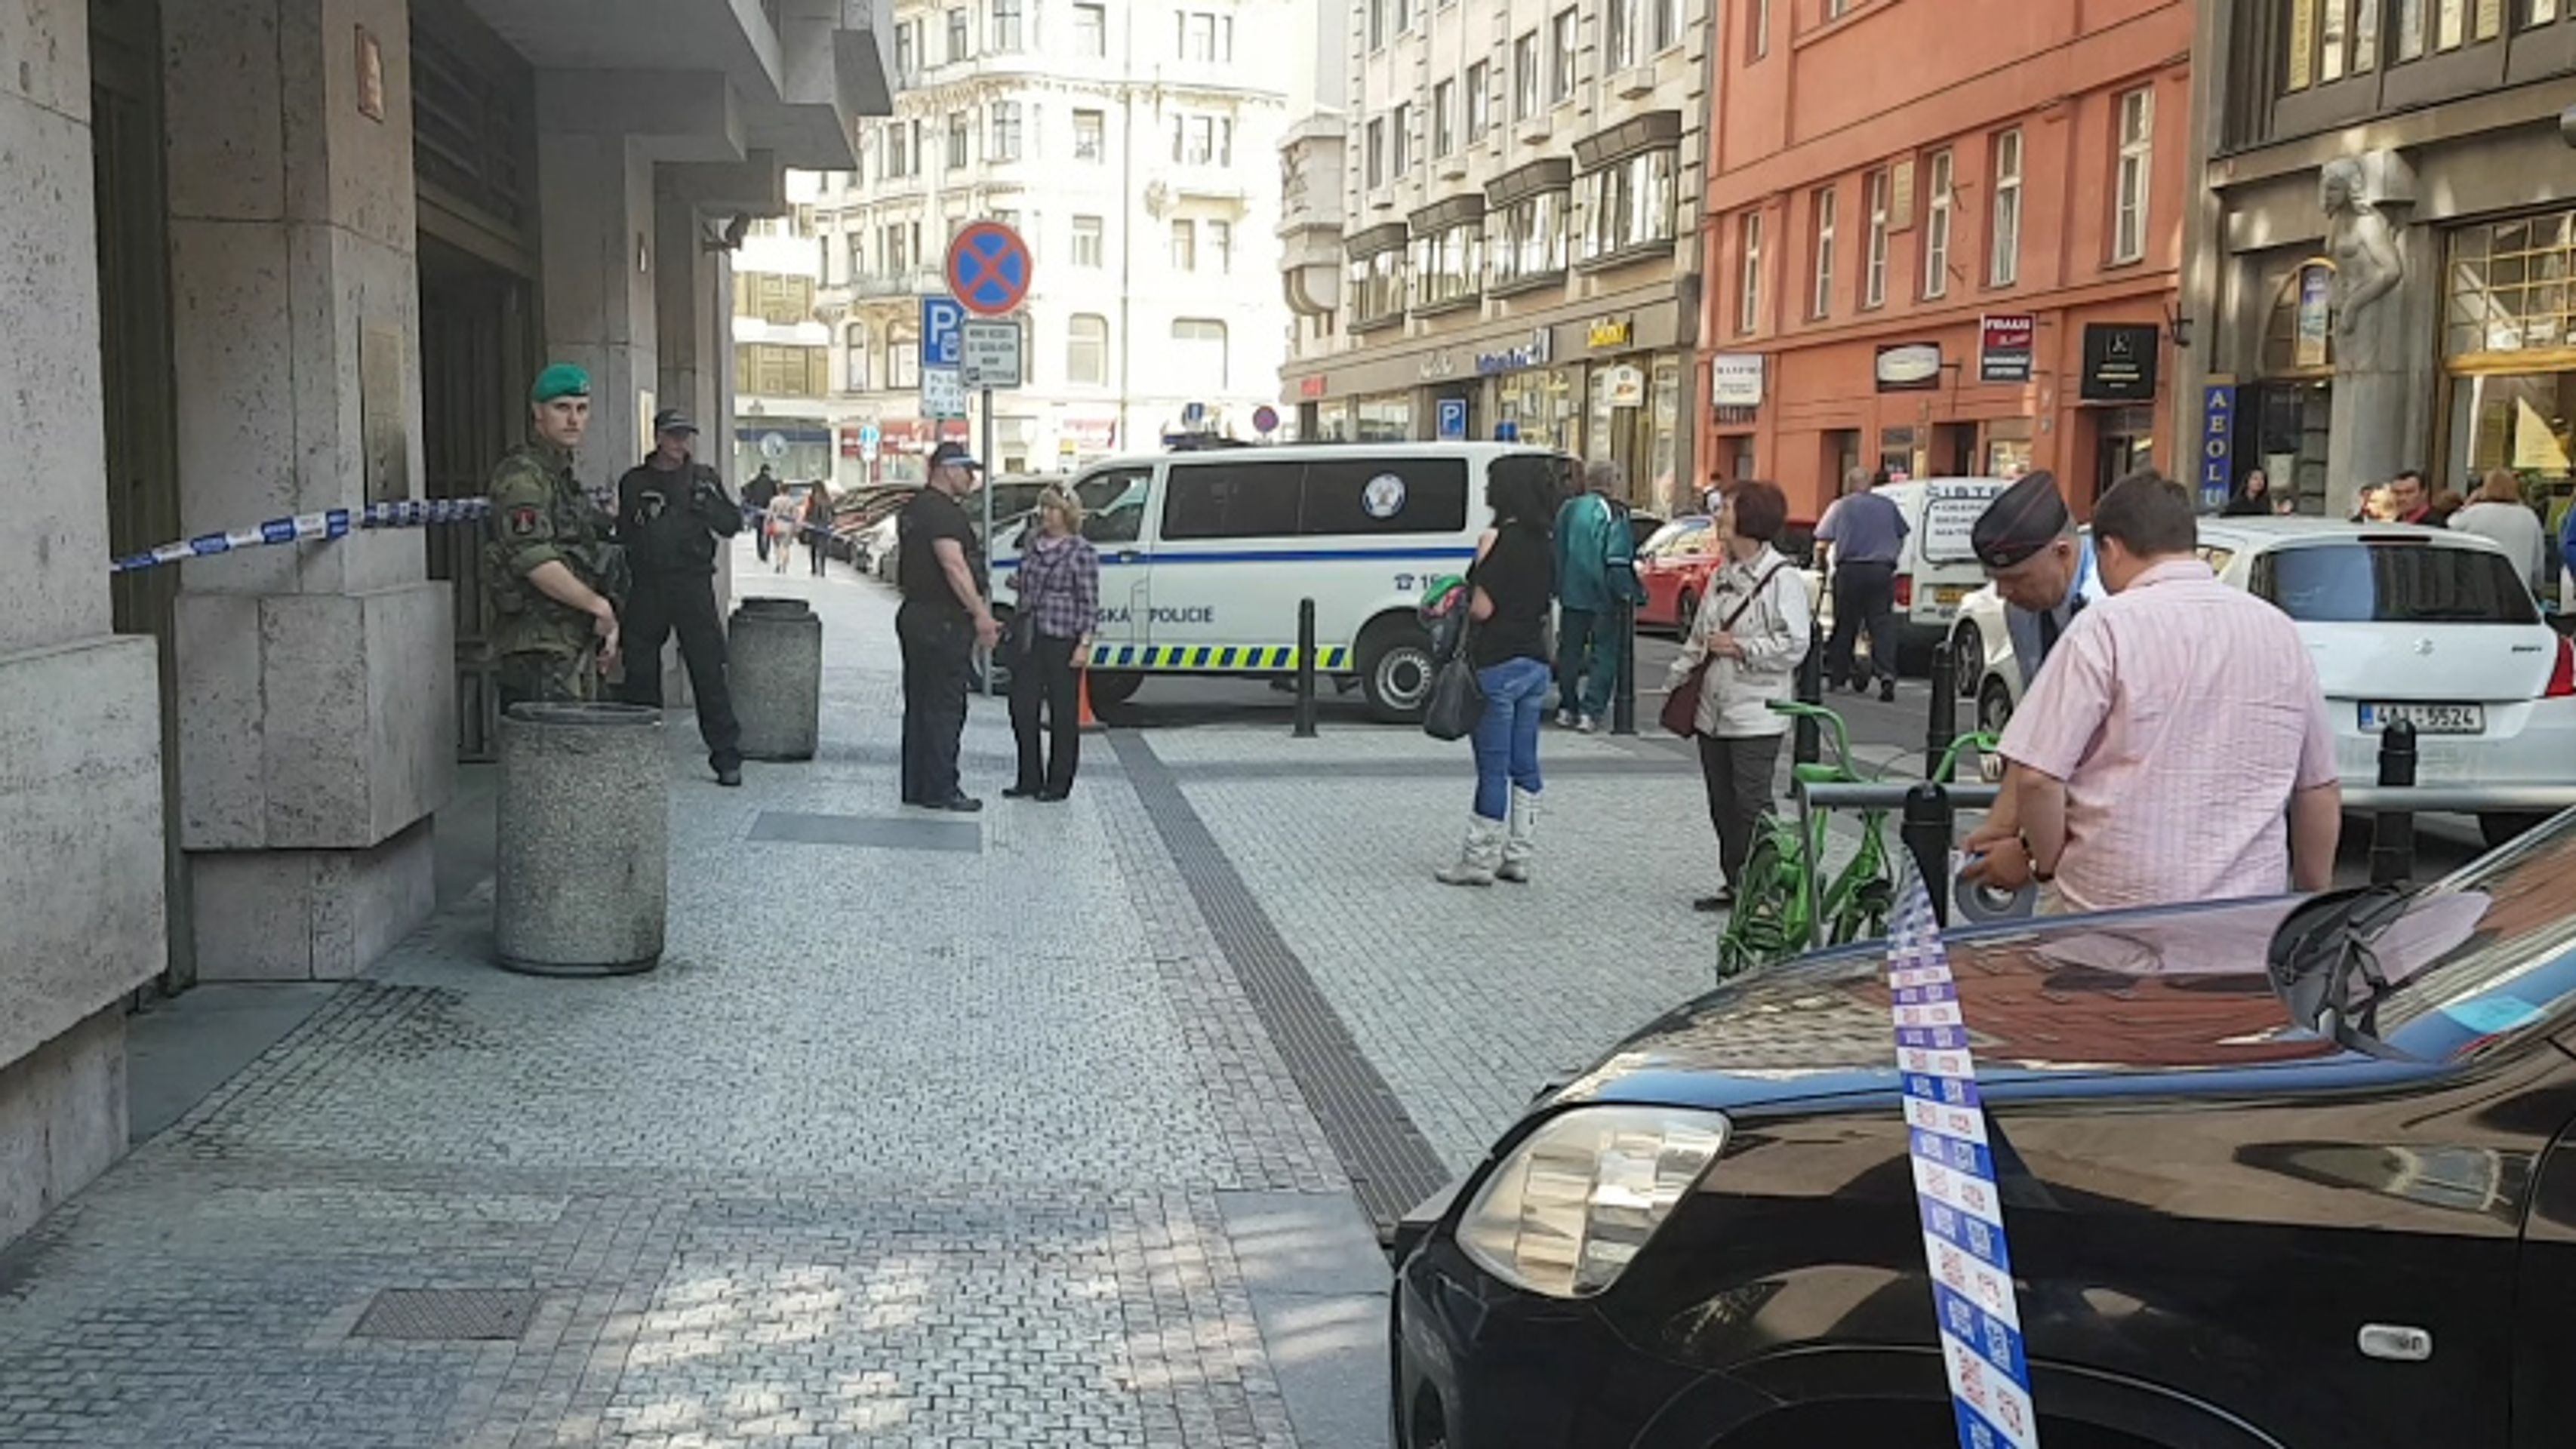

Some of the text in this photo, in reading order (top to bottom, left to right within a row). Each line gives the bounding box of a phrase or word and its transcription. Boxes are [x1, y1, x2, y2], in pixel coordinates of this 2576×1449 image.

[930, 305, 957, 345] P
[1442, 406, 1459, 432] P
[2205, 389, 2227, 516] AEOLU
[1096, 604, 1214, 623] SKÁ POLICIE
